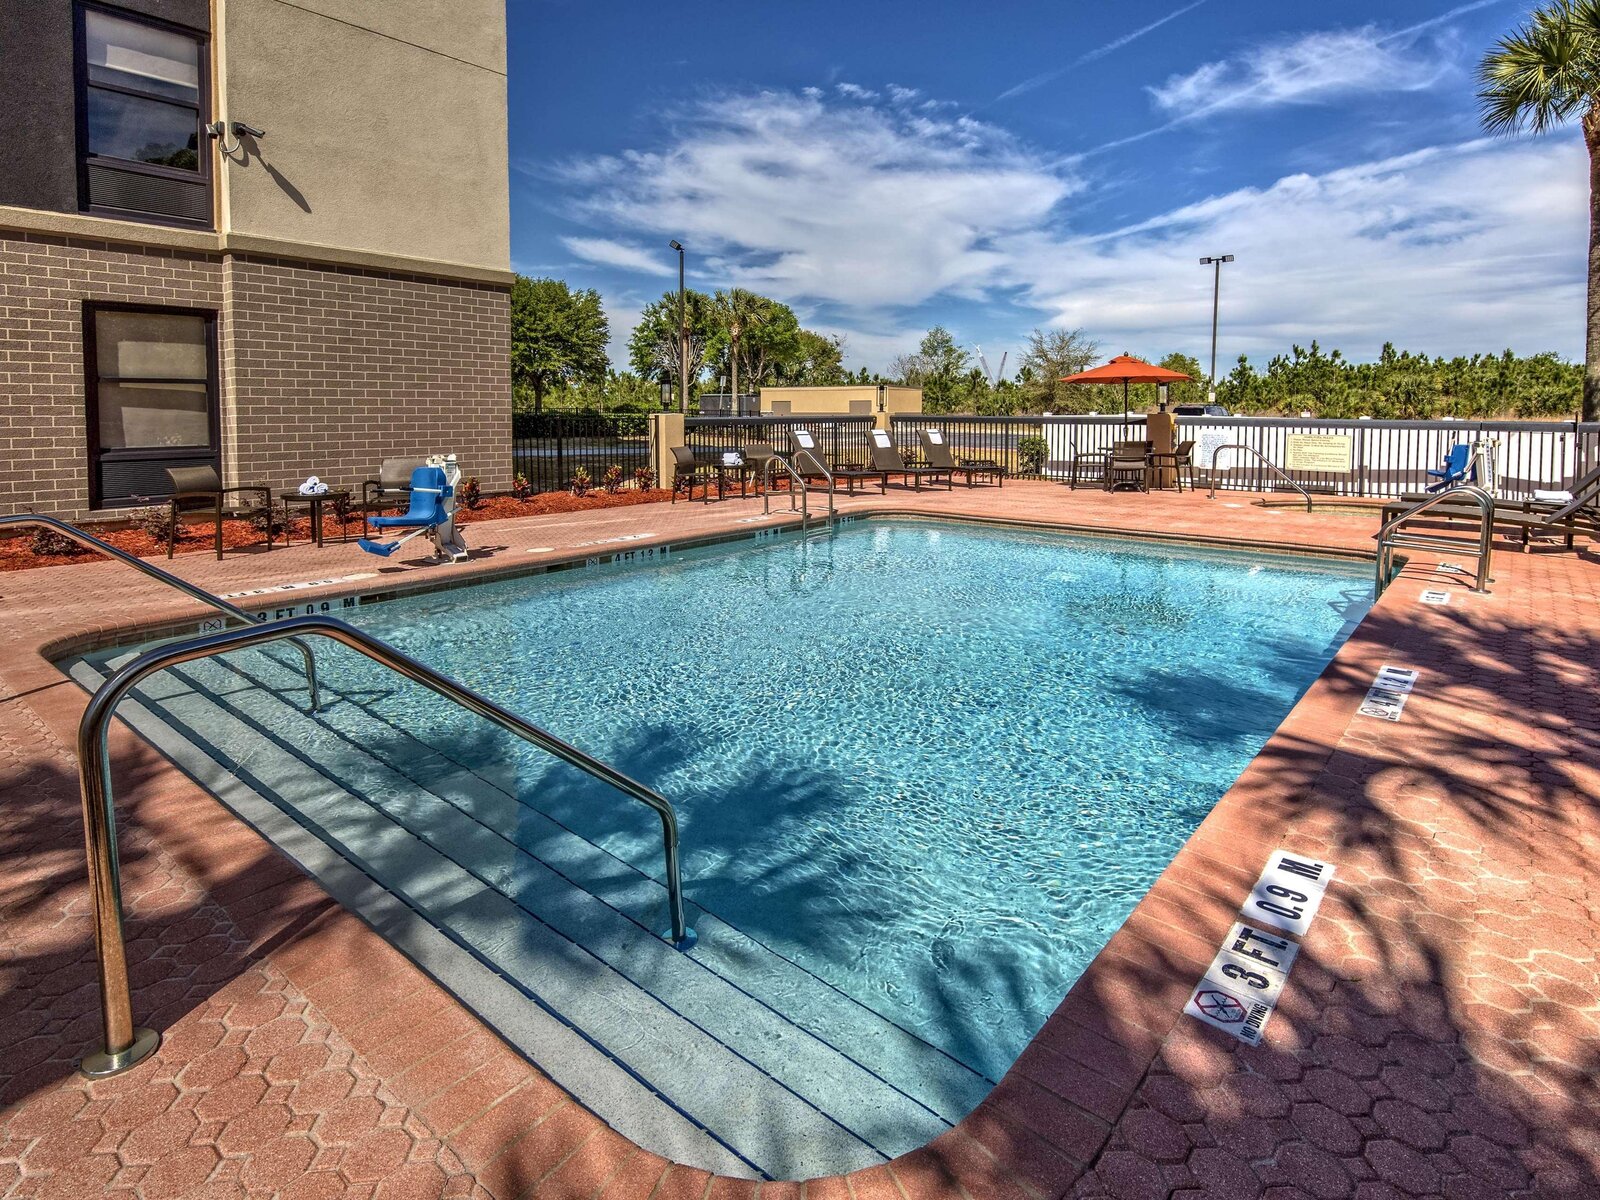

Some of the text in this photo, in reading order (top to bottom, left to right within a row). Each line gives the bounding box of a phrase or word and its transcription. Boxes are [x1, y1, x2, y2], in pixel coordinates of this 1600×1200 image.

[625, 551, 636, 561] FT
[275, 607, 296, 620] FT
[343, 597, 355, 608] M
[1221, 963, 1270, 990] 3
[1255, 884, 1309, 920] 0.9
[1240, 1003, 1269, 1040] NO DIVING
